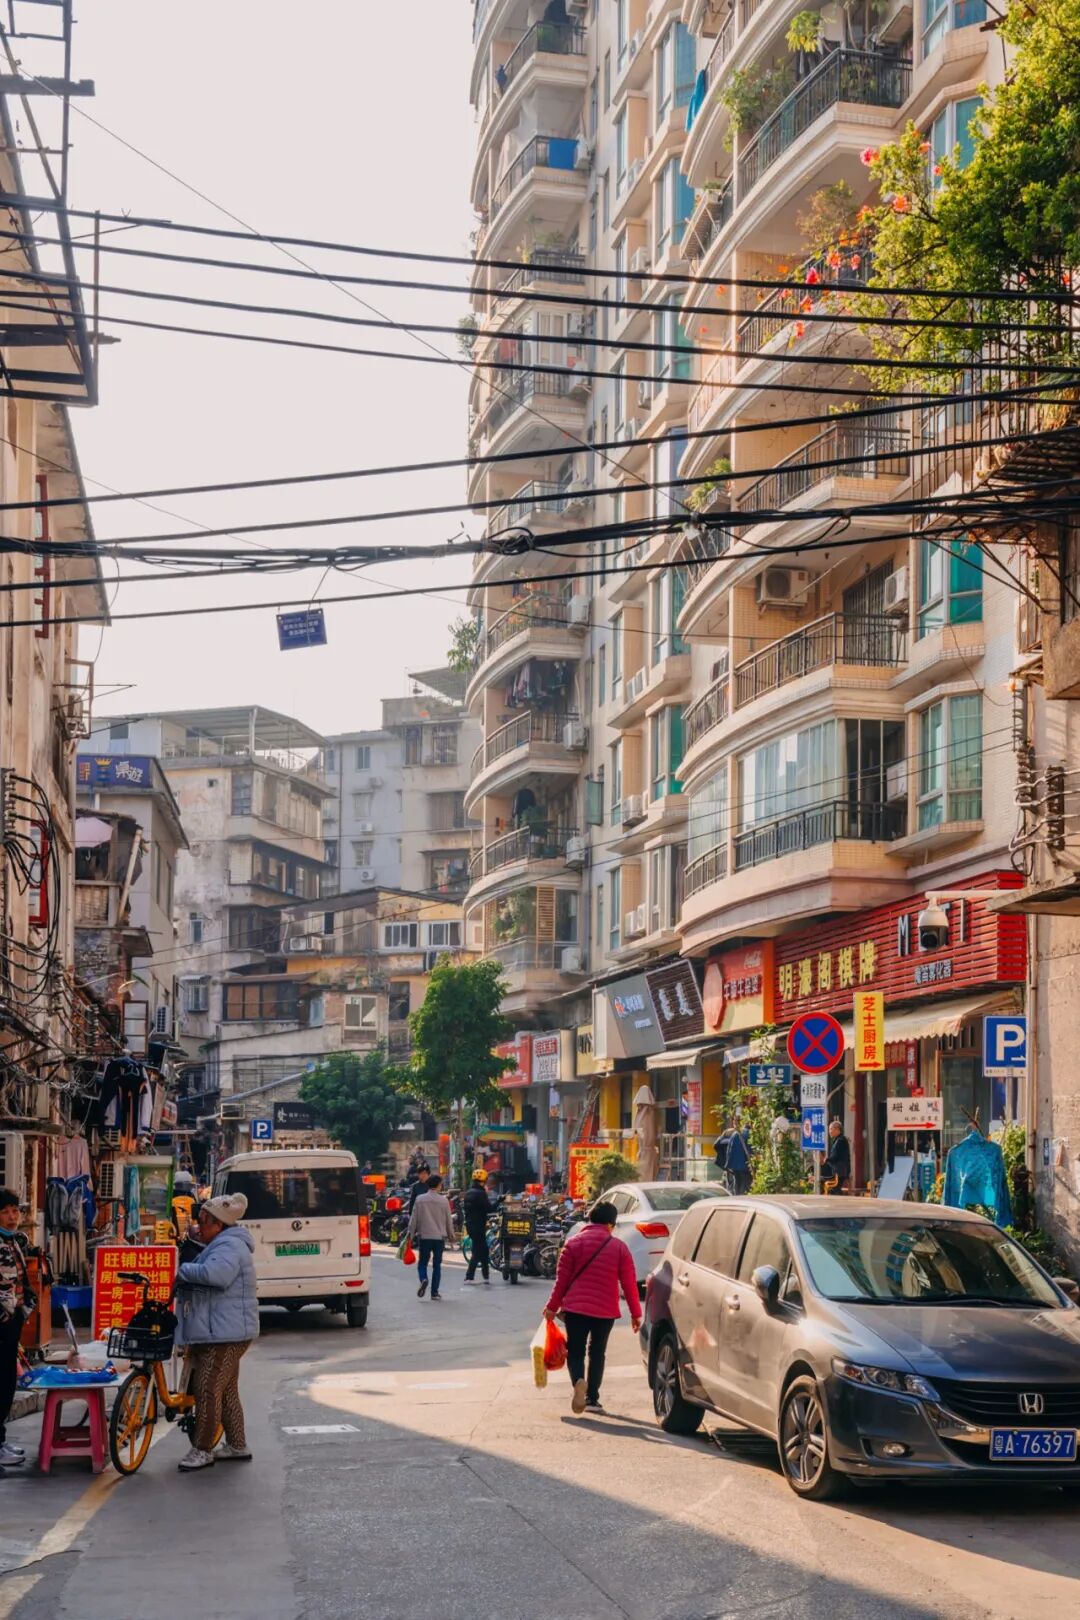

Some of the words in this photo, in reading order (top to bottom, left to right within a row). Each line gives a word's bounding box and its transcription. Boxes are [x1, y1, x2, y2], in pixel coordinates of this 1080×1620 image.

[862, 996, 876, 1060] 芝士厨房
[996, 1024, 1025, 1061] P
[256, 1122, 269, 1138] P
[104, 1252, 171, 1268] 旺铺出租
